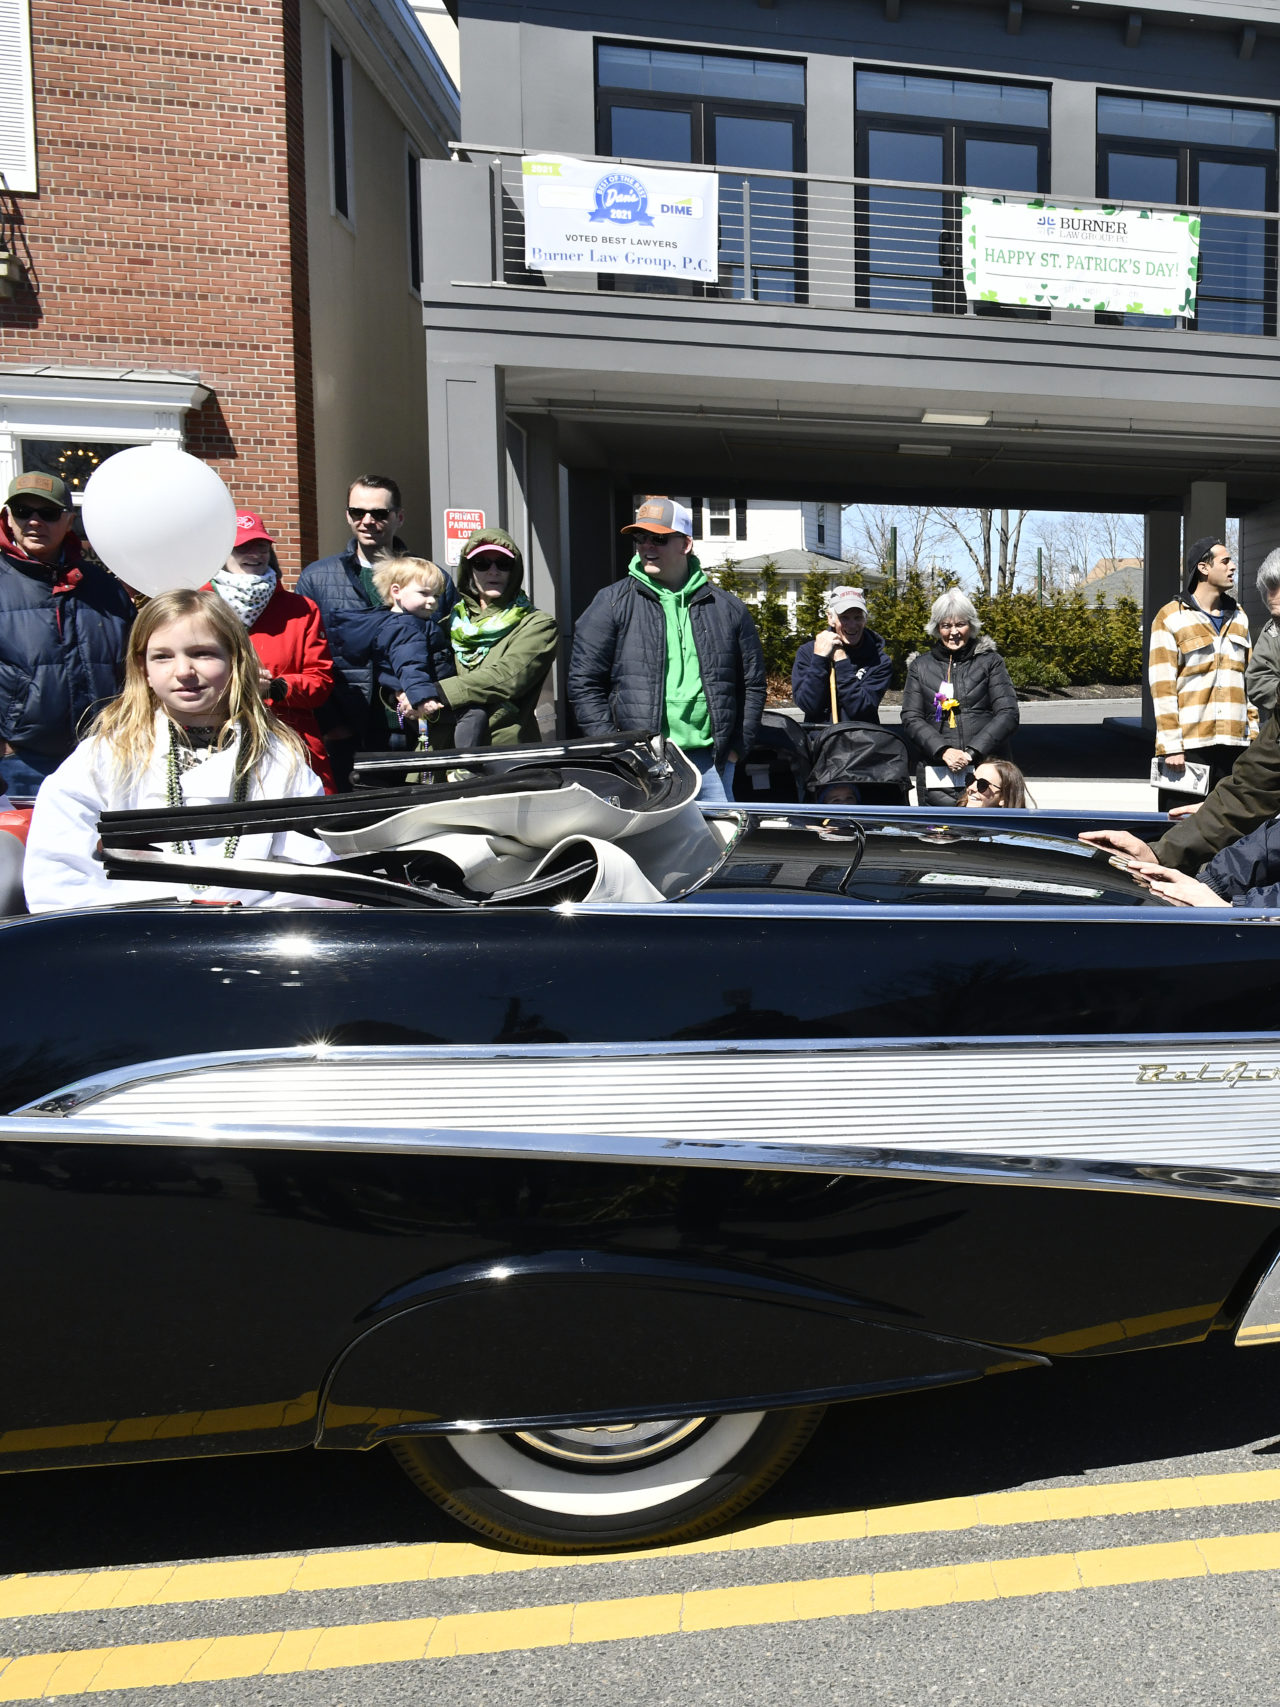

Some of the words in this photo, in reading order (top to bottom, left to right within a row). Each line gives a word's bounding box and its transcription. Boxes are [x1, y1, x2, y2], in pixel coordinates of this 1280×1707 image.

[610, 208, 632, 220] 2021
[660, 203, 693, 216] DIME
[1059, 216, 1129, 235] BURNER
[565, 233, 598, 243] VOTED
[601, 236, 627, 245] BEST
[630, 238, 678, 249] LAWYERS
[1059, 230, 1080, 240] LAW
[532, 247, 584, 262] Burner
[590, 249, 619, 263] Law
[624, 251, 676, 270] Group,
[682, 256, 712, 273] P.C.
[984, 247, 1036, 266] HAPPY
[1040, 252, 1062, 269] ST.
[1066, 255, 1141, 275] PATRICK'S
[1145, 261, 1180, 278] DAY!
[449, 512, 480, 521] PRIVATE
[448, 521, 482, 530] PARKING
[457, 530, 472, 538] LOT
